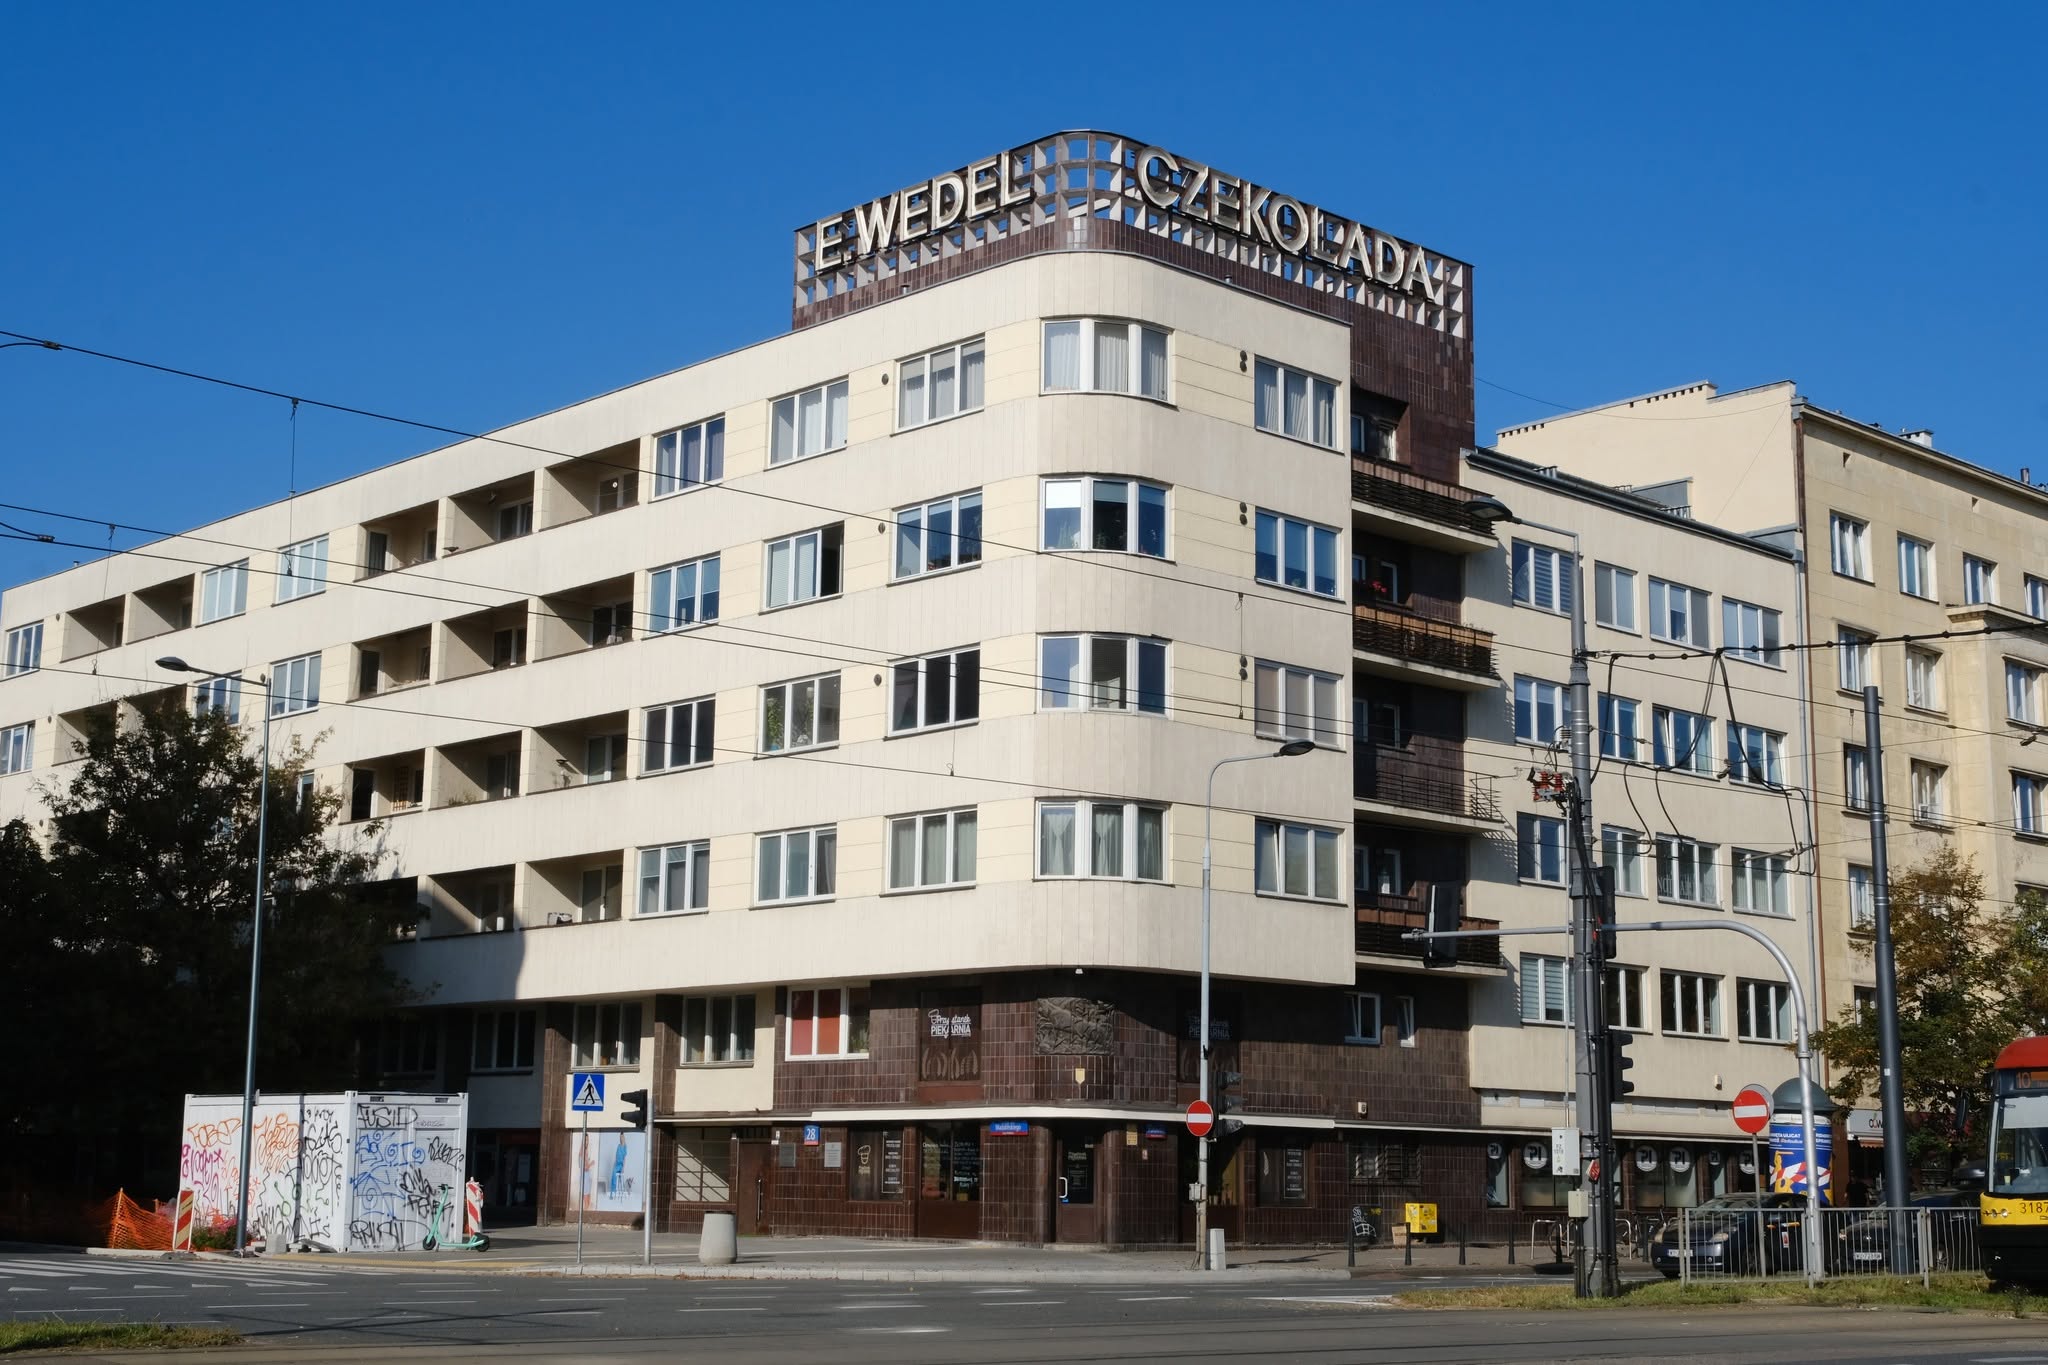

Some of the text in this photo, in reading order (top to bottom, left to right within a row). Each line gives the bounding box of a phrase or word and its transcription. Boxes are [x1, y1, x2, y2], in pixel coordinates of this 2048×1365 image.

[1136, 147, 1435, 300] CZEKOLADA
[931, 1024, 971, 1035] PIEKARNIA
[2018, 1071, 2031, 1089] 10
[806, 1128, 817, 1140] 28
